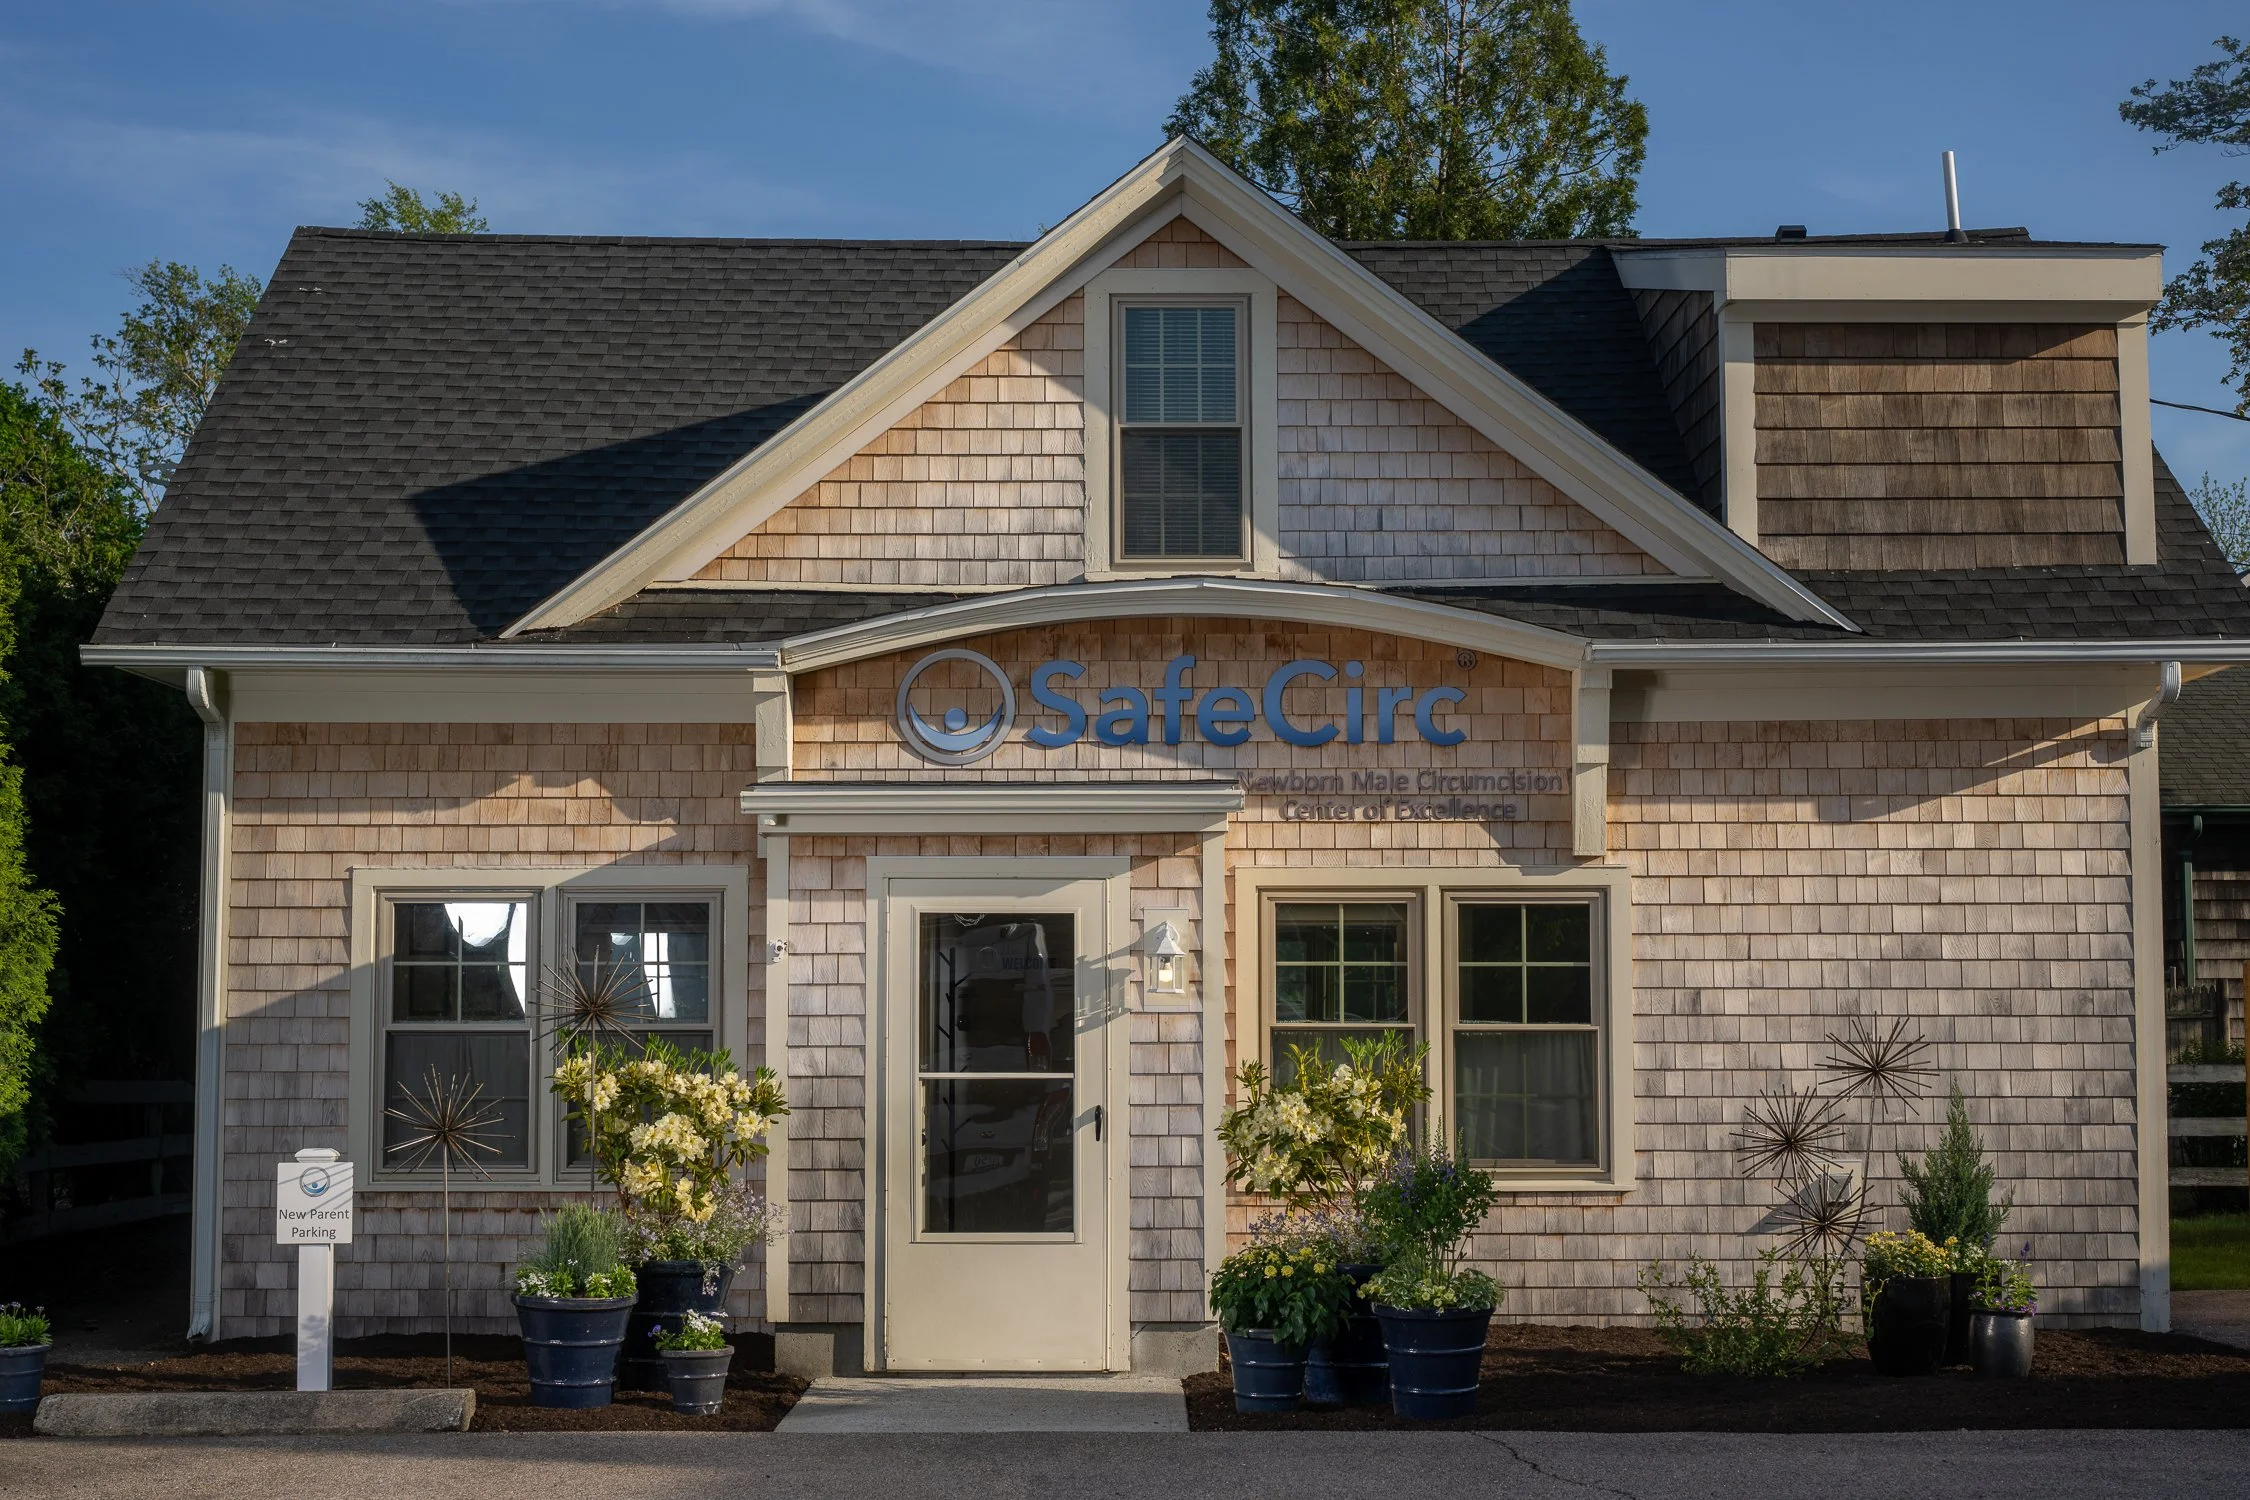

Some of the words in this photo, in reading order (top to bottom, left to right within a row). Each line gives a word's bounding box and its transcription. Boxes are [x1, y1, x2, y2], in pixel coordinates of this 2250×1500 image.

[1027, 655, 1468, 747] SafeCirc
[1236, 770, 1344, 792] Newborn
[1351, 770, 1409, 791] Male
[1416, 769, 1563, 792] Circumcision
[1278, 799, 1360, 821] Center
[1363, 796, 1393, 820] of
[1395, 799, 1518, 820] Excellence
[279, 1209, 307, 1220] New
[310, 1209, 350, 1220] Parent
[291, 1227, 336, 1240] Parking
